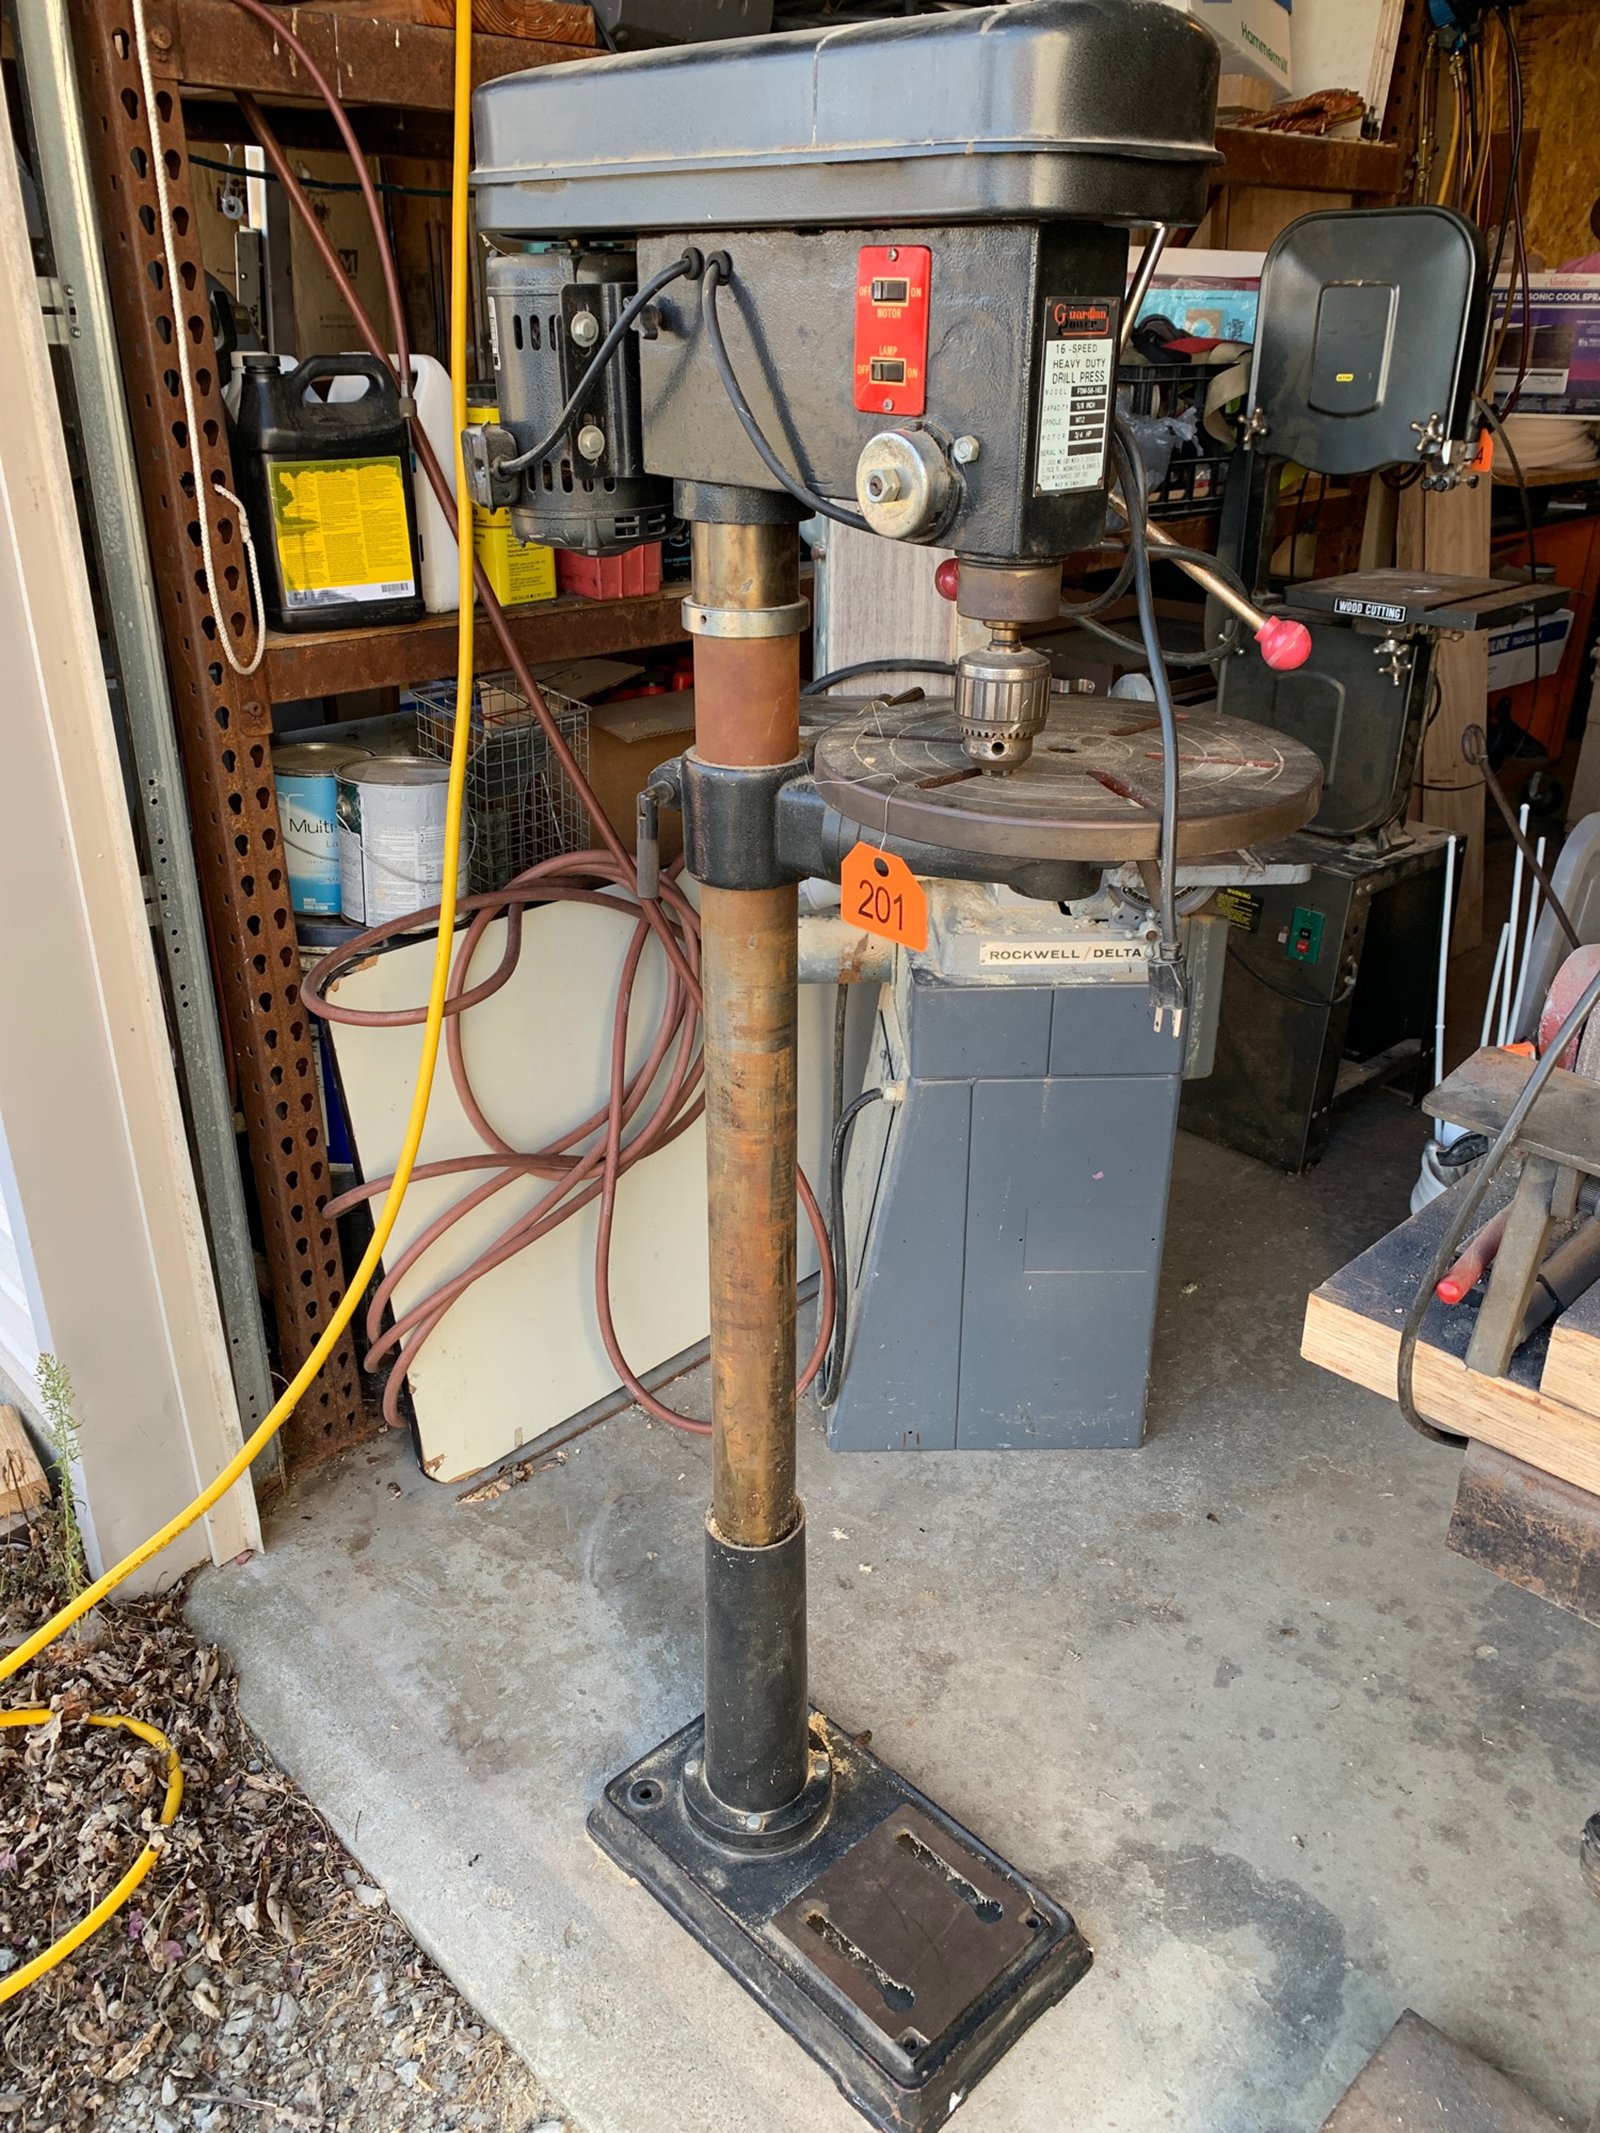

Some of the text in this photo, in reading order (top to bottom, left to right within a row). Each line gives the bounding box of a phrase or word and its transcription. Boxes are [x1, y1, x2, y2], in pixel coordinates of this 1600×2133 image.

[1241, 20, 1288, 75] Hammermill
[910, 287, 922, 298] ON
[1556, 292, 1581, 301] COOL
[876, 307, 902, 319] MOTOR
[1053, 303, 1107, 324] Guardian
[878, 345, 898, 356] LAMP
[1056, 343, 1066, 354] 16
[1053, 357, 1106, 369] HEAVY DUTY
[857, 364, 918, 378] OFF ON
[1052, 370, 1105, 384] DRILL PRESS
[1042, 432, 1066, 441] MOTOR
[1339, 600, 1401, 619] WOOD CUTTING
[858, 879, 904, 931] 201
[989, 948, 1081, 960] ROCKWELL
[1093, 948, 1143, 959] DELTA
